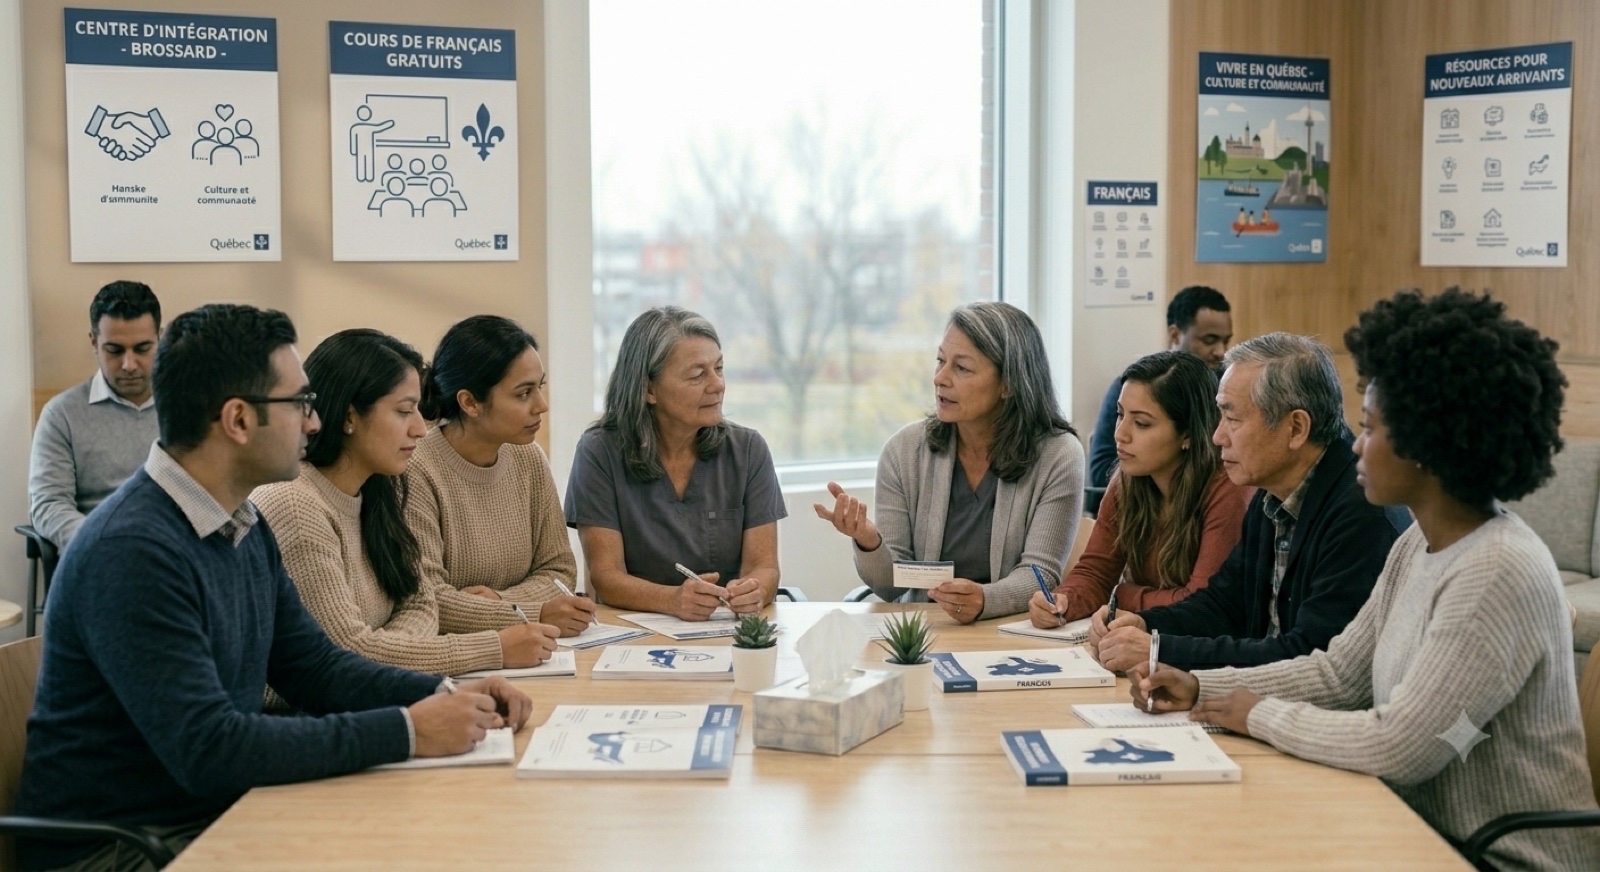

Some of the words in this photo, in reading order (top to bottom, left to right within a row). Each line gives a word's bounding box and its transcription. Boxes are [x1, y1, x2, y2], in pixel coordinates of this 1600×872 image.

[75, 20, 139, 37] CENTRE
[143, 22, 269, 43] D'INTÉGRATION
[131, 42, 217, 59] BROSSARD
[343, 32, 398, 48] COURS
[402, 35, 422, 49] DE
[426, 36, 502, 54] FRANÇAIS
[386, 53, 462, 69] GRATUITS
[1216, 62, 1247, 75] VIVRE
[1250, 63, 1264, 76] EN
[1445, 57, 1511, 74] RÉSOURCES
[1514, 53, 1548, 67] POUR
[1205, 77, 1247, 89] CULTURE
[1248, 79, 1259, 89] ET
[1430, 74, 1494, 91] NOUVEAUX
[1497, 68, 1565, 86] ARRIVANTS
[112, 184, 146, 193] Hanske
[204, 186, 238, 194] Culture
[240, 186, 249, 194] et
[1093, 186, 1151, 203] FRANÇAIS
[455, 238, 491, 250] Québec
